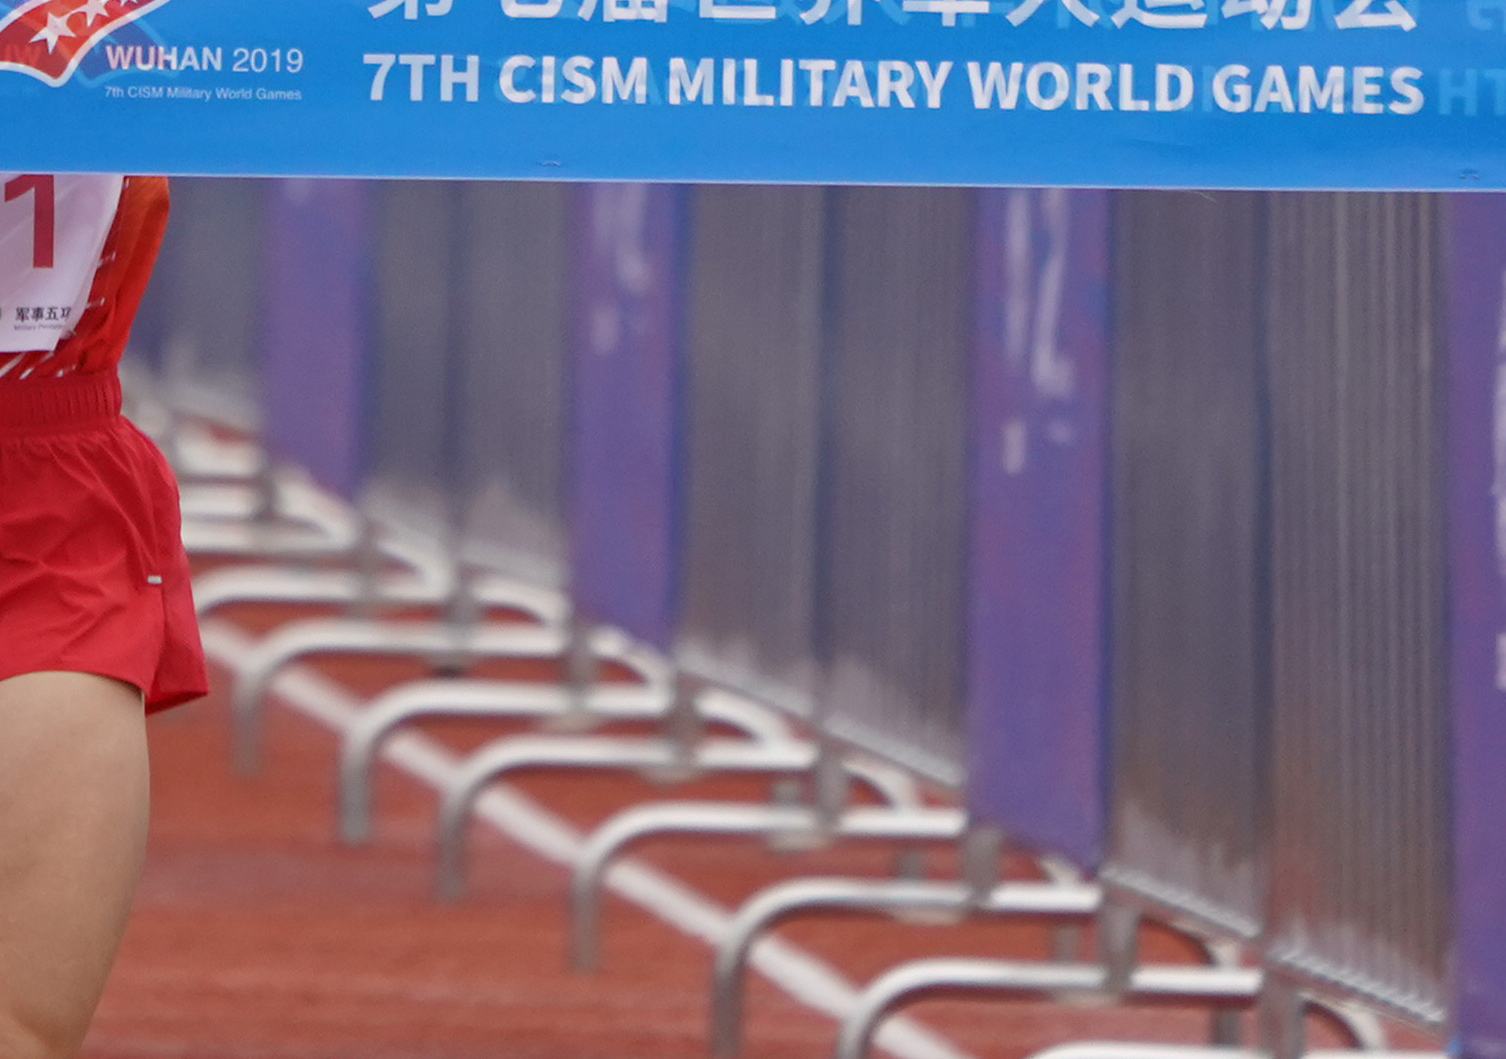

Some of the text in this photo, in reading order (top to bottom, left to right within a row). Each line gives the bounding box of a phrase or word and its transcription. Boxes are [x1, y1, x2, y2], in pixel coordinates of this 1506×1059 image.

[105, 44, 304, 73] WUHAN 2019
[105, 86, 302, 102] 7th CISM Military World Games
[362, 52, 479, 102] 7TH
[498, 54, 648, 105] CISM
[668, 57, 954, 109] MILITARY
[965, 61, 1195, 113] WORLD
[1211, 63, 1425, 116] GAMES
